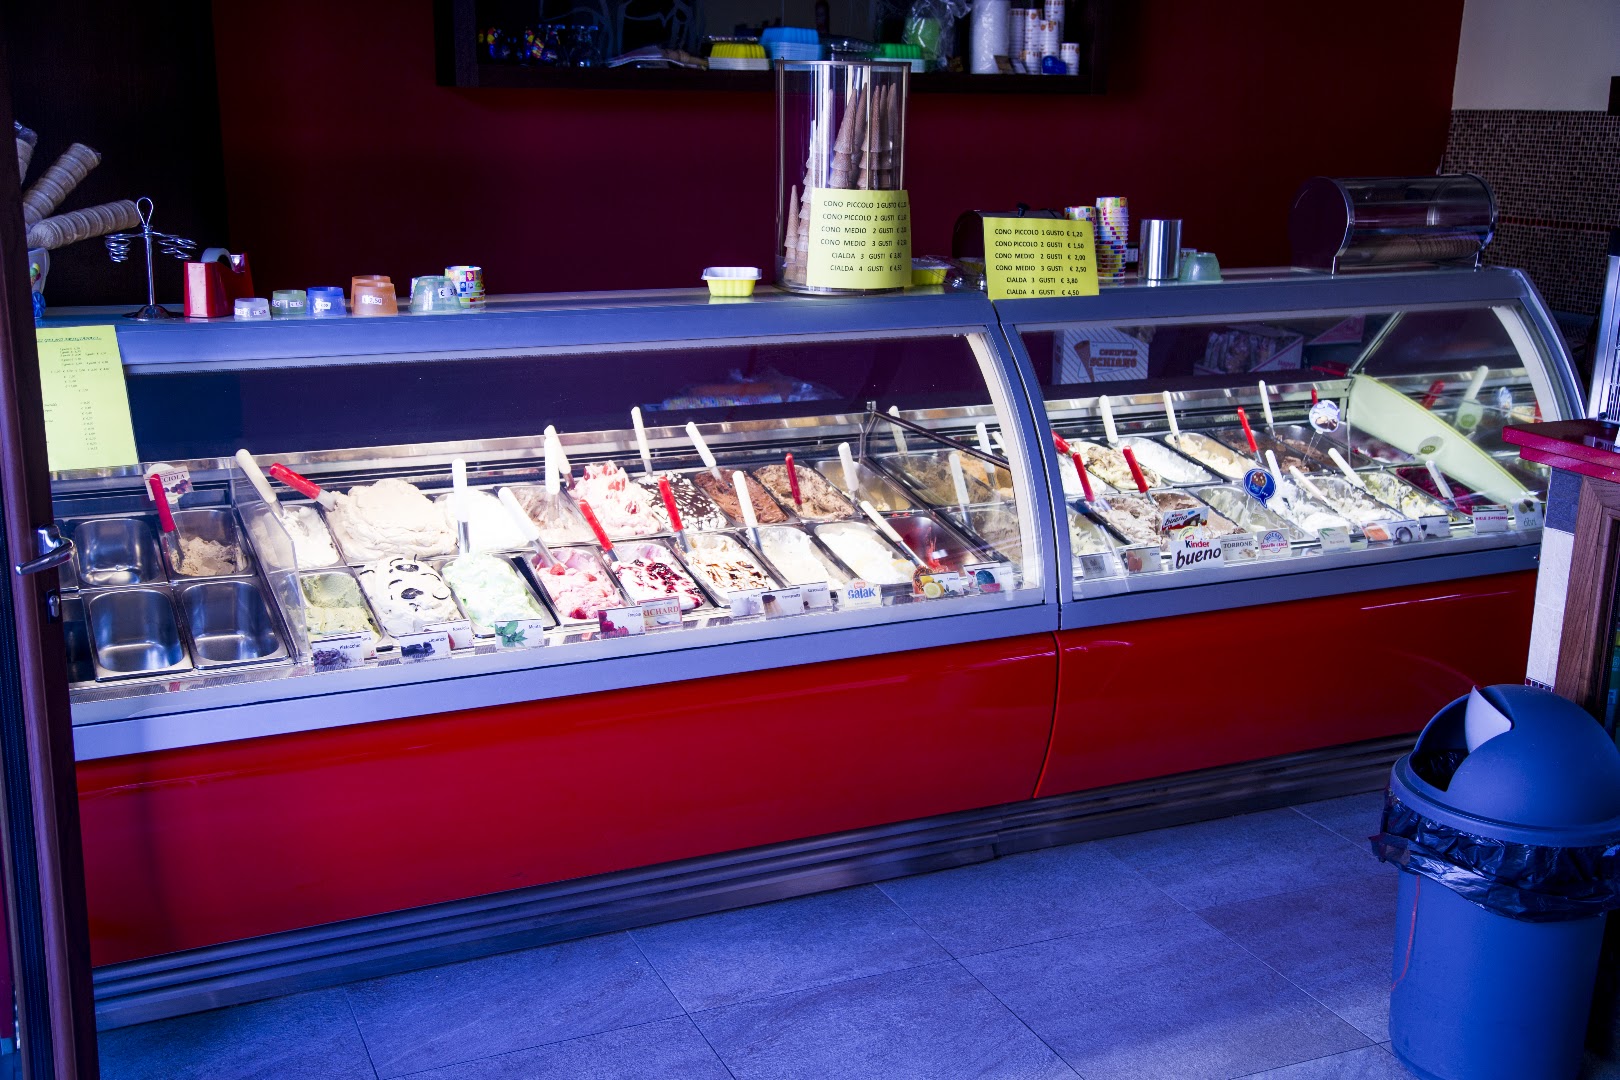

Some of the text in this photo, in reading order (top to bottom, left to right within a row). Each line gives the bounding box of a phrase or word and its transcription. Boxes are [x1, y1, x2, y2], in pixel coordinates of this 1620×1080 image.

[1185, 540, 1210, 548] Kinder
[1176, 548, 1221, 569] bueno
[848, 588, 876, 599] Galak
